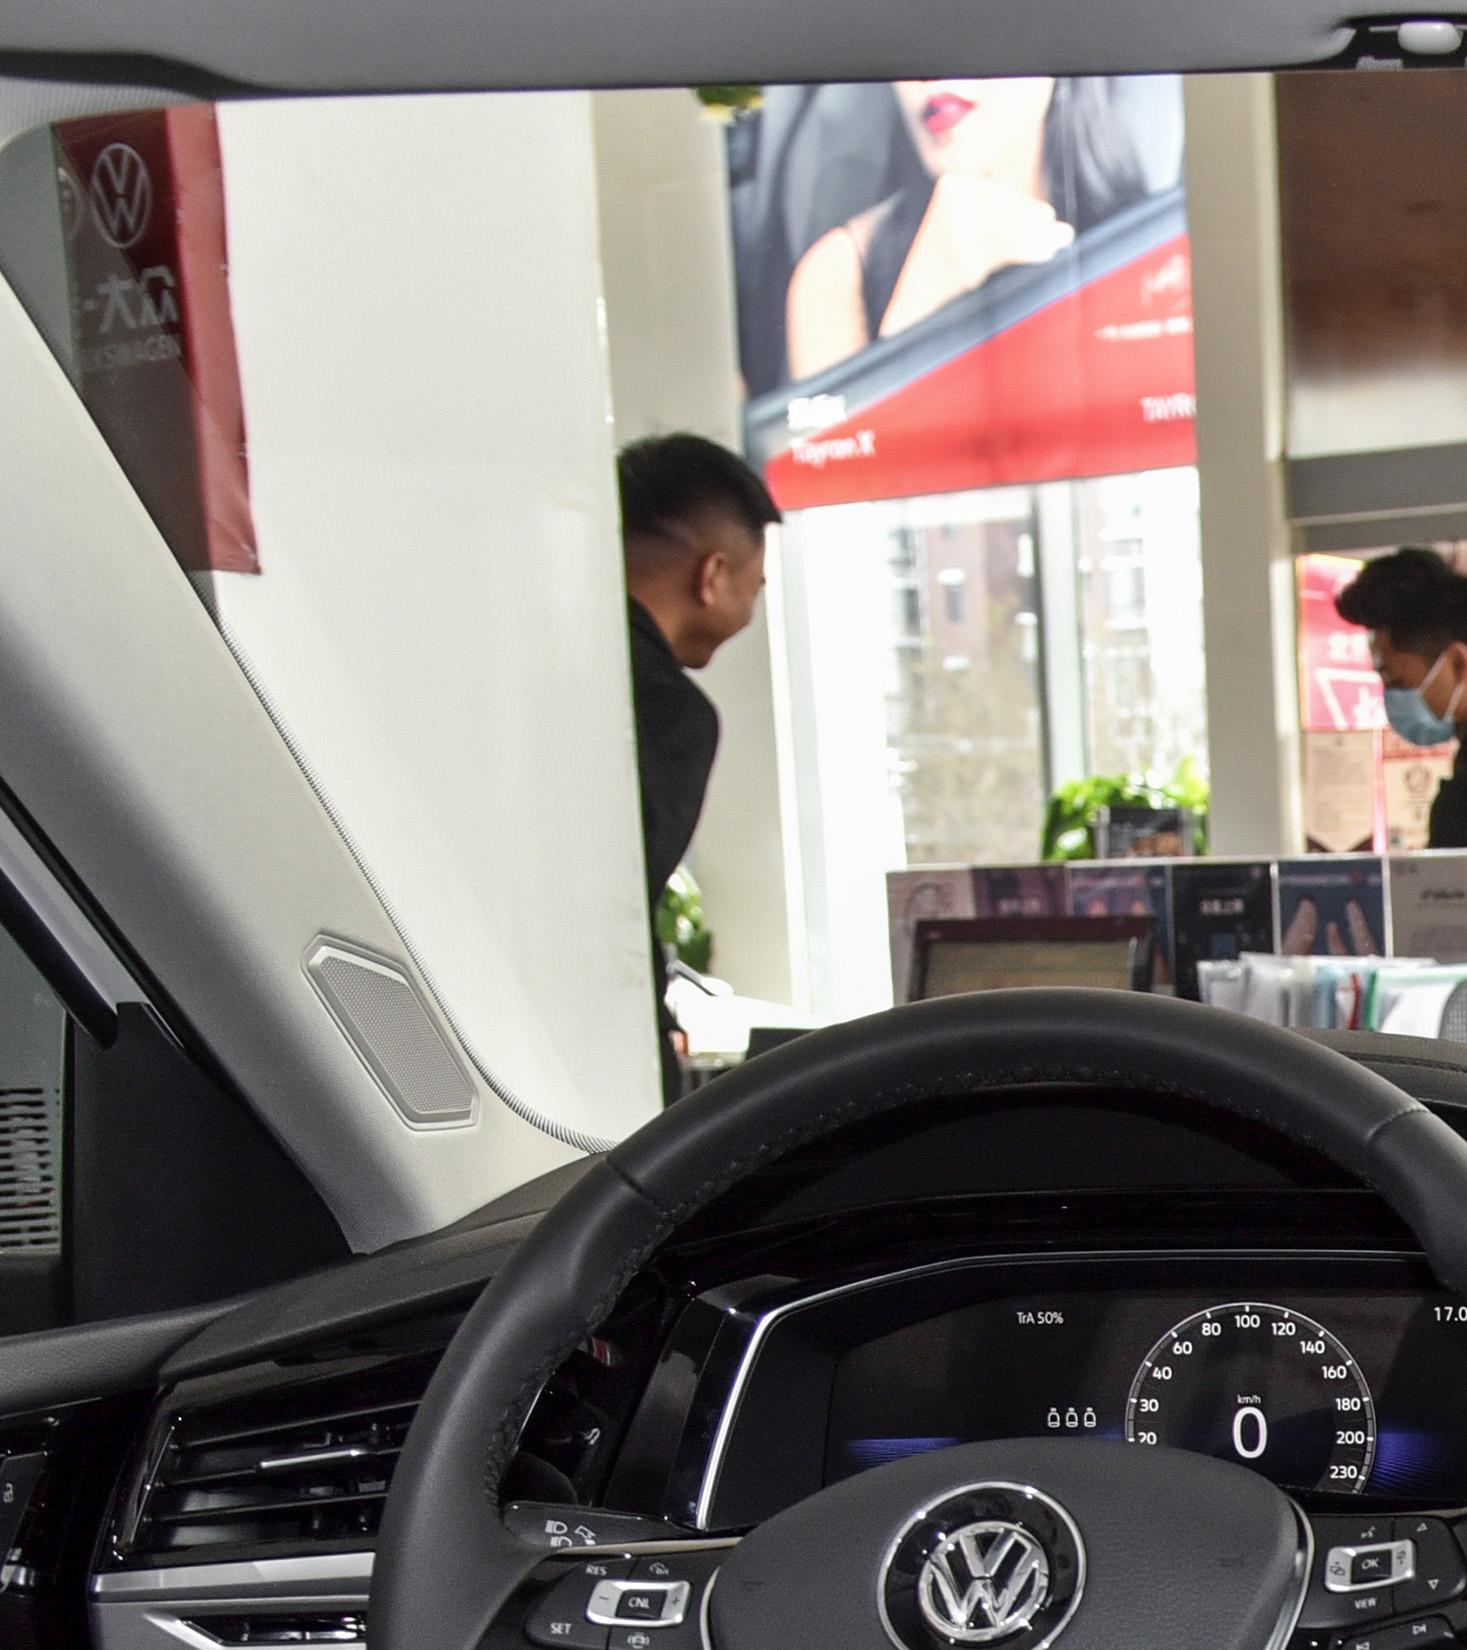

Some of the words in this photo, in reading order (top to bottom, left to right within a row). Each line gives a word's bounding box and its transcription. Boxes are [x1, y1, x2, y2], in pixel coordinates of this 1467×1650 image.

[1037, 1312, 1064, 1324] 50%
[1234, 1315, 1261, 1329] 100
[1201, 1322, 1222, 1336] 80
[1271, 1322, 1296, 1336] 120
[1172, 1341, 1193, 1355] 60
[1300, 1341, 1326, 1354] 140
[1153, 1366, 1173, 1380] 40
[1322, 1365, 1347, 1379] 160
[1237, 1394, 1262, 1404] km/h
[1336, 1398, 1361, 1411] 180
[1140, 1399, 1159, 1413] 30
[1138, 1432, 1157, 1445] 20
[1232, 1406, 1268, 1459] 0
[1336, 1431, 1364, 1445] 200
[1330, 1465, 1357, 1479] 230
[585, 1564, 608, 1576] RES
[1361, 1558, 1380, 1570] OK
[628, 1597, 650, 1609] CNL
[1354, 1597, 1378, 1609] VIEW
[550, 1622, 573, 1634] SET
